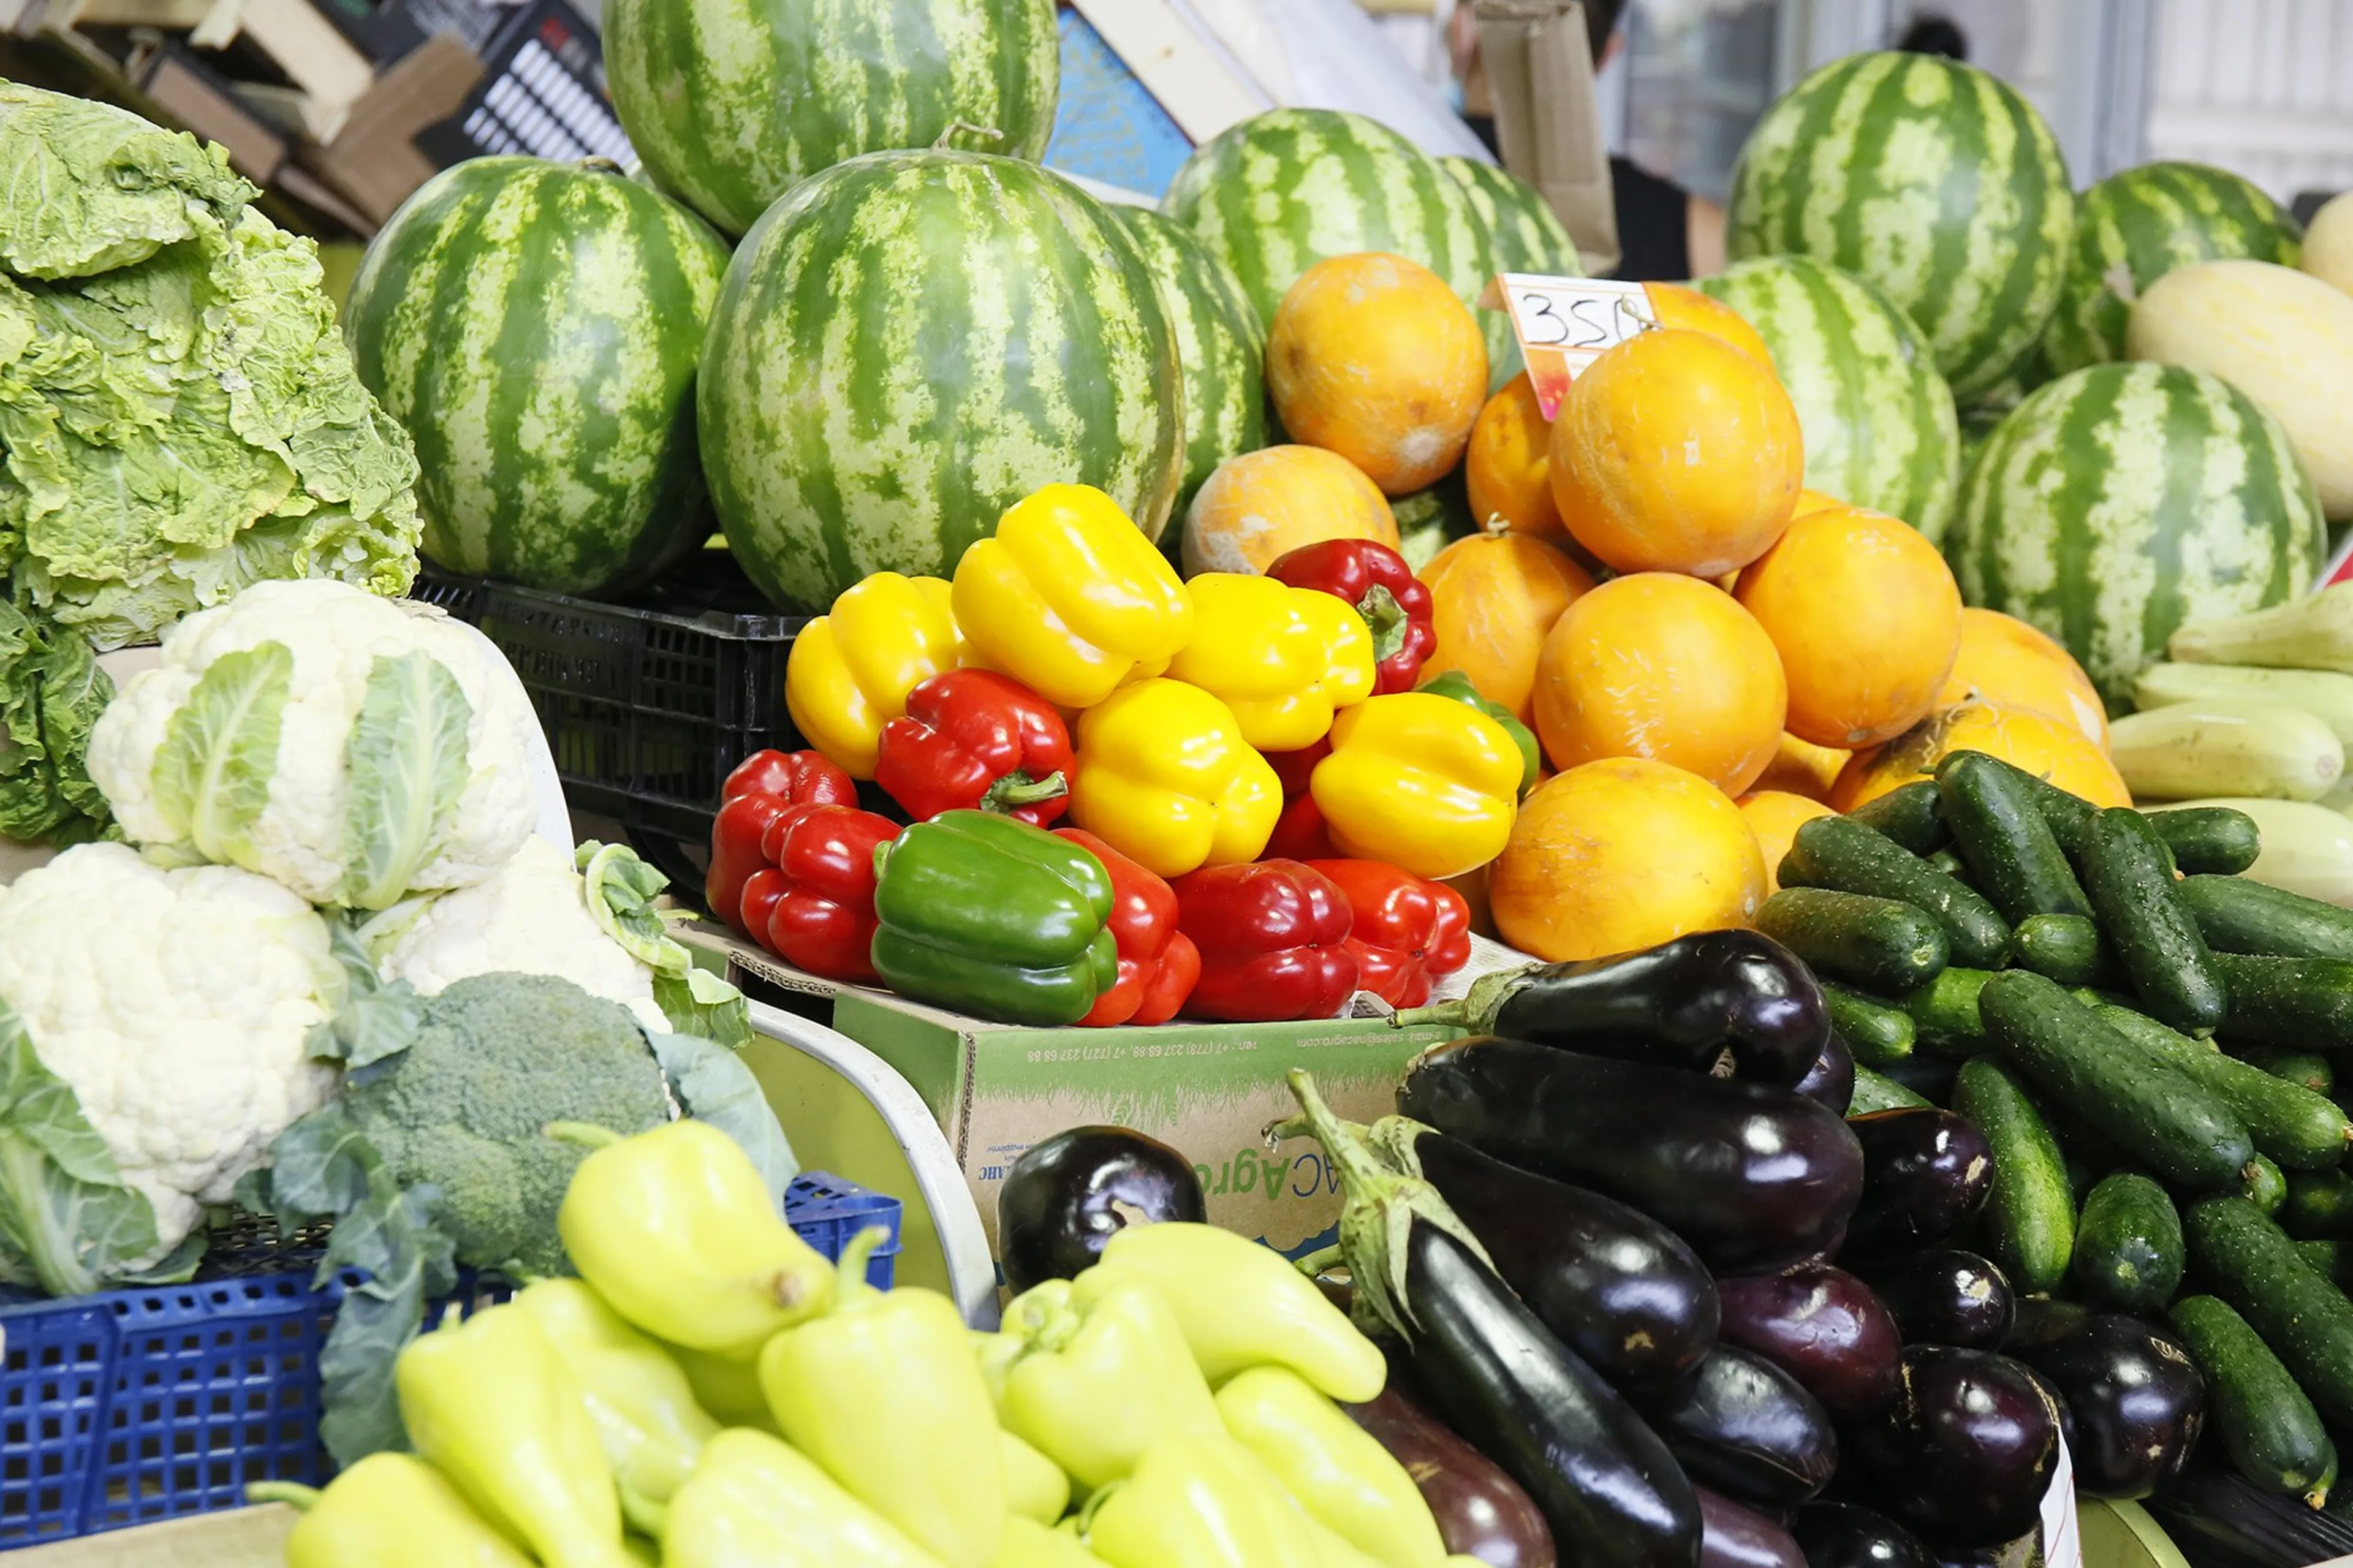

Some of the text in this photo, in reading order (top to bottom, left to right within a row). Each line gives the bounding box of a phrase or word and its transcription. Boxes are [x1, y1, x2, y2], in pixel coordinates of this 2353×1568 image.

[1297, 1032, 1441, 1047] e-mail: sales@nacagro.com
[1083, 1045, 1110, 1060] (727)
[1113, 1047, 1126, 1058] +7
[1148, 1045, 1161, 1057] 68
[1164, 1044, 1184, 1056] 237
[1216, 1043, 1229, 1054] +7
[1028, 1050, 1040, 1062] 88
[1044, 1050, 1057, 1061] 68
[1061, 1049, 1080, 1061] 237
[1194, 1148, 1338, 1200] ACAgro
